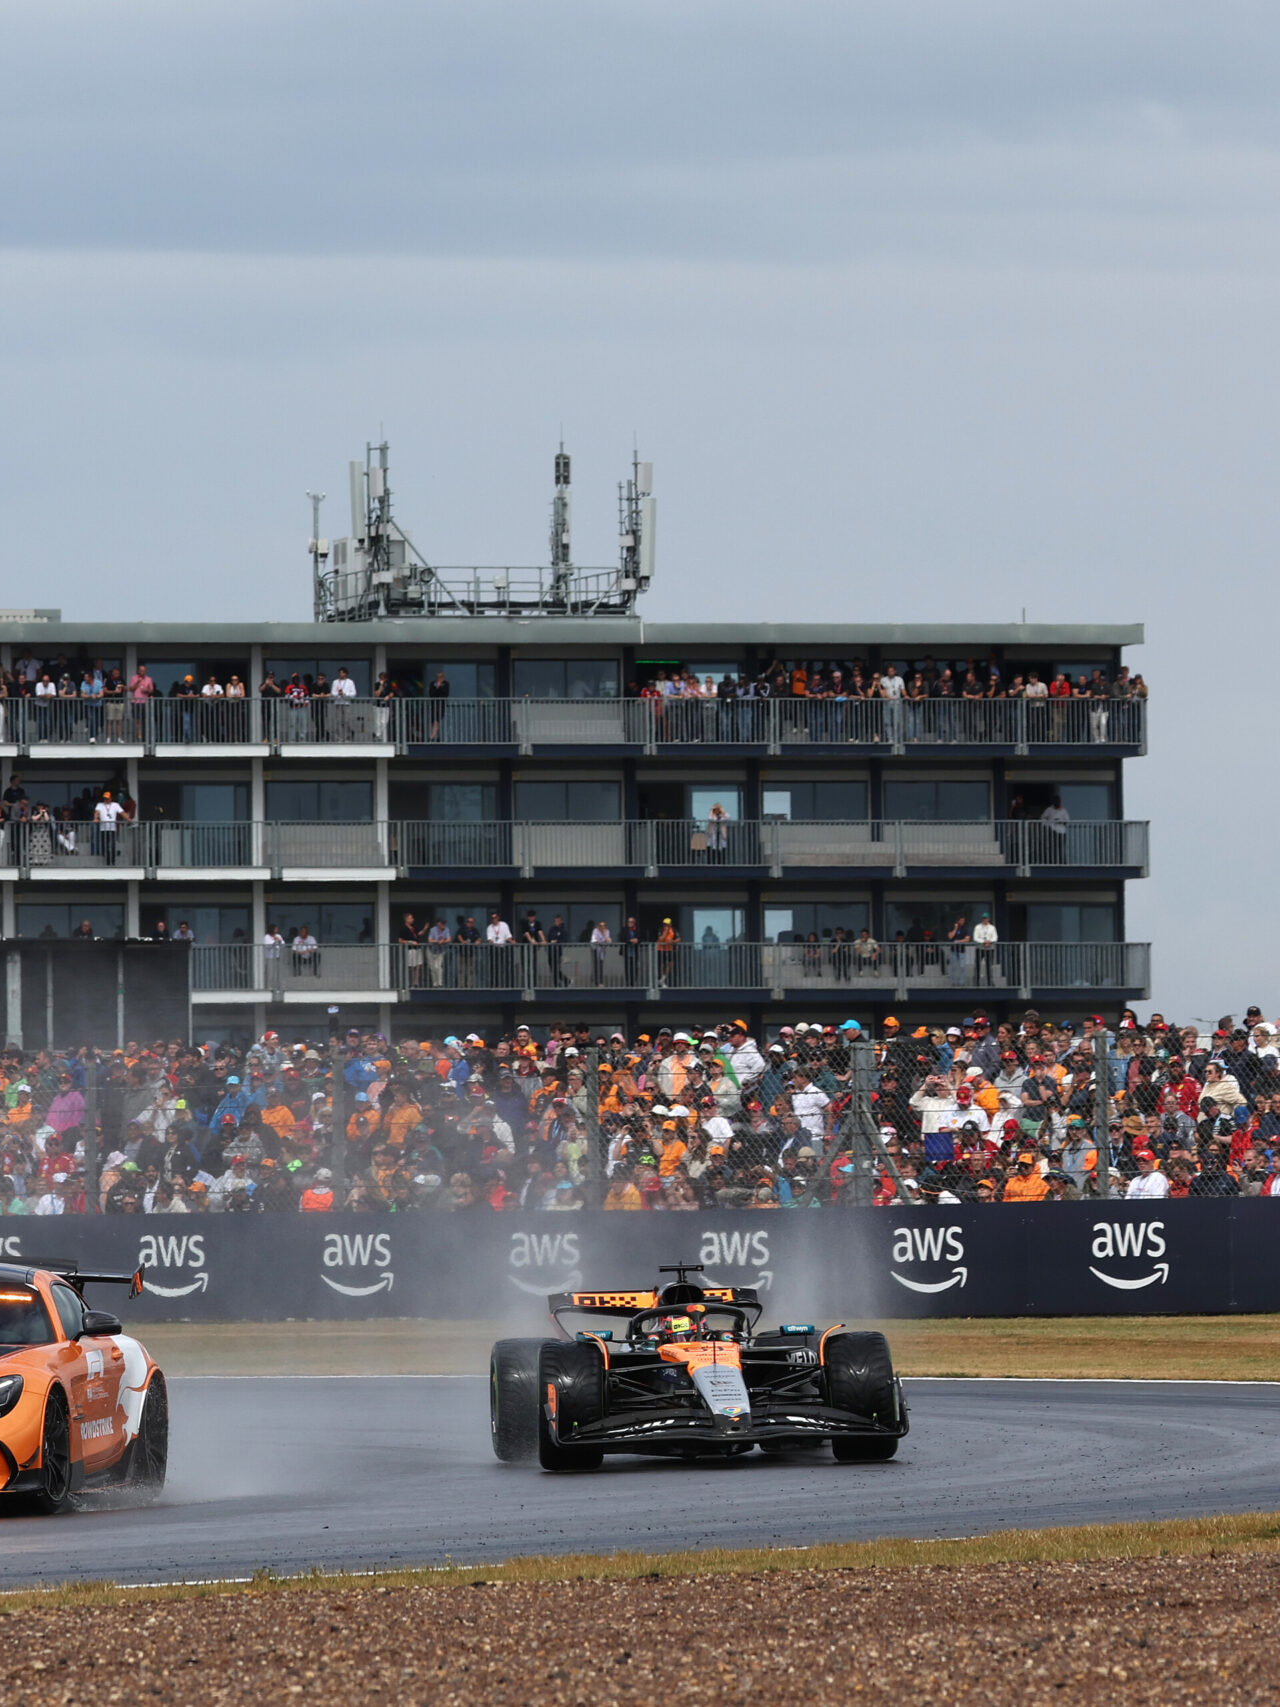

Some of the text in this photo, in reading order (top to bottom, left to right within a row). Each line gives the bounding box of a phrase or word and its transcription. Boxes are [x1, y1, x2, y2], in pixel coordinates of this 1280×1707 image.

[138, 1234, 206, 1268] aws
[323, 1233, 392, 1267] aws
[509, 1232, 580, 1267] aws
[698, 1230, 770, 1266] aws
[892, 1225, 964, 1263] aws
[1091, 1220, 1166, 1258] aws
[80, 1416, 114, 1440] ROWDSTRIKE
